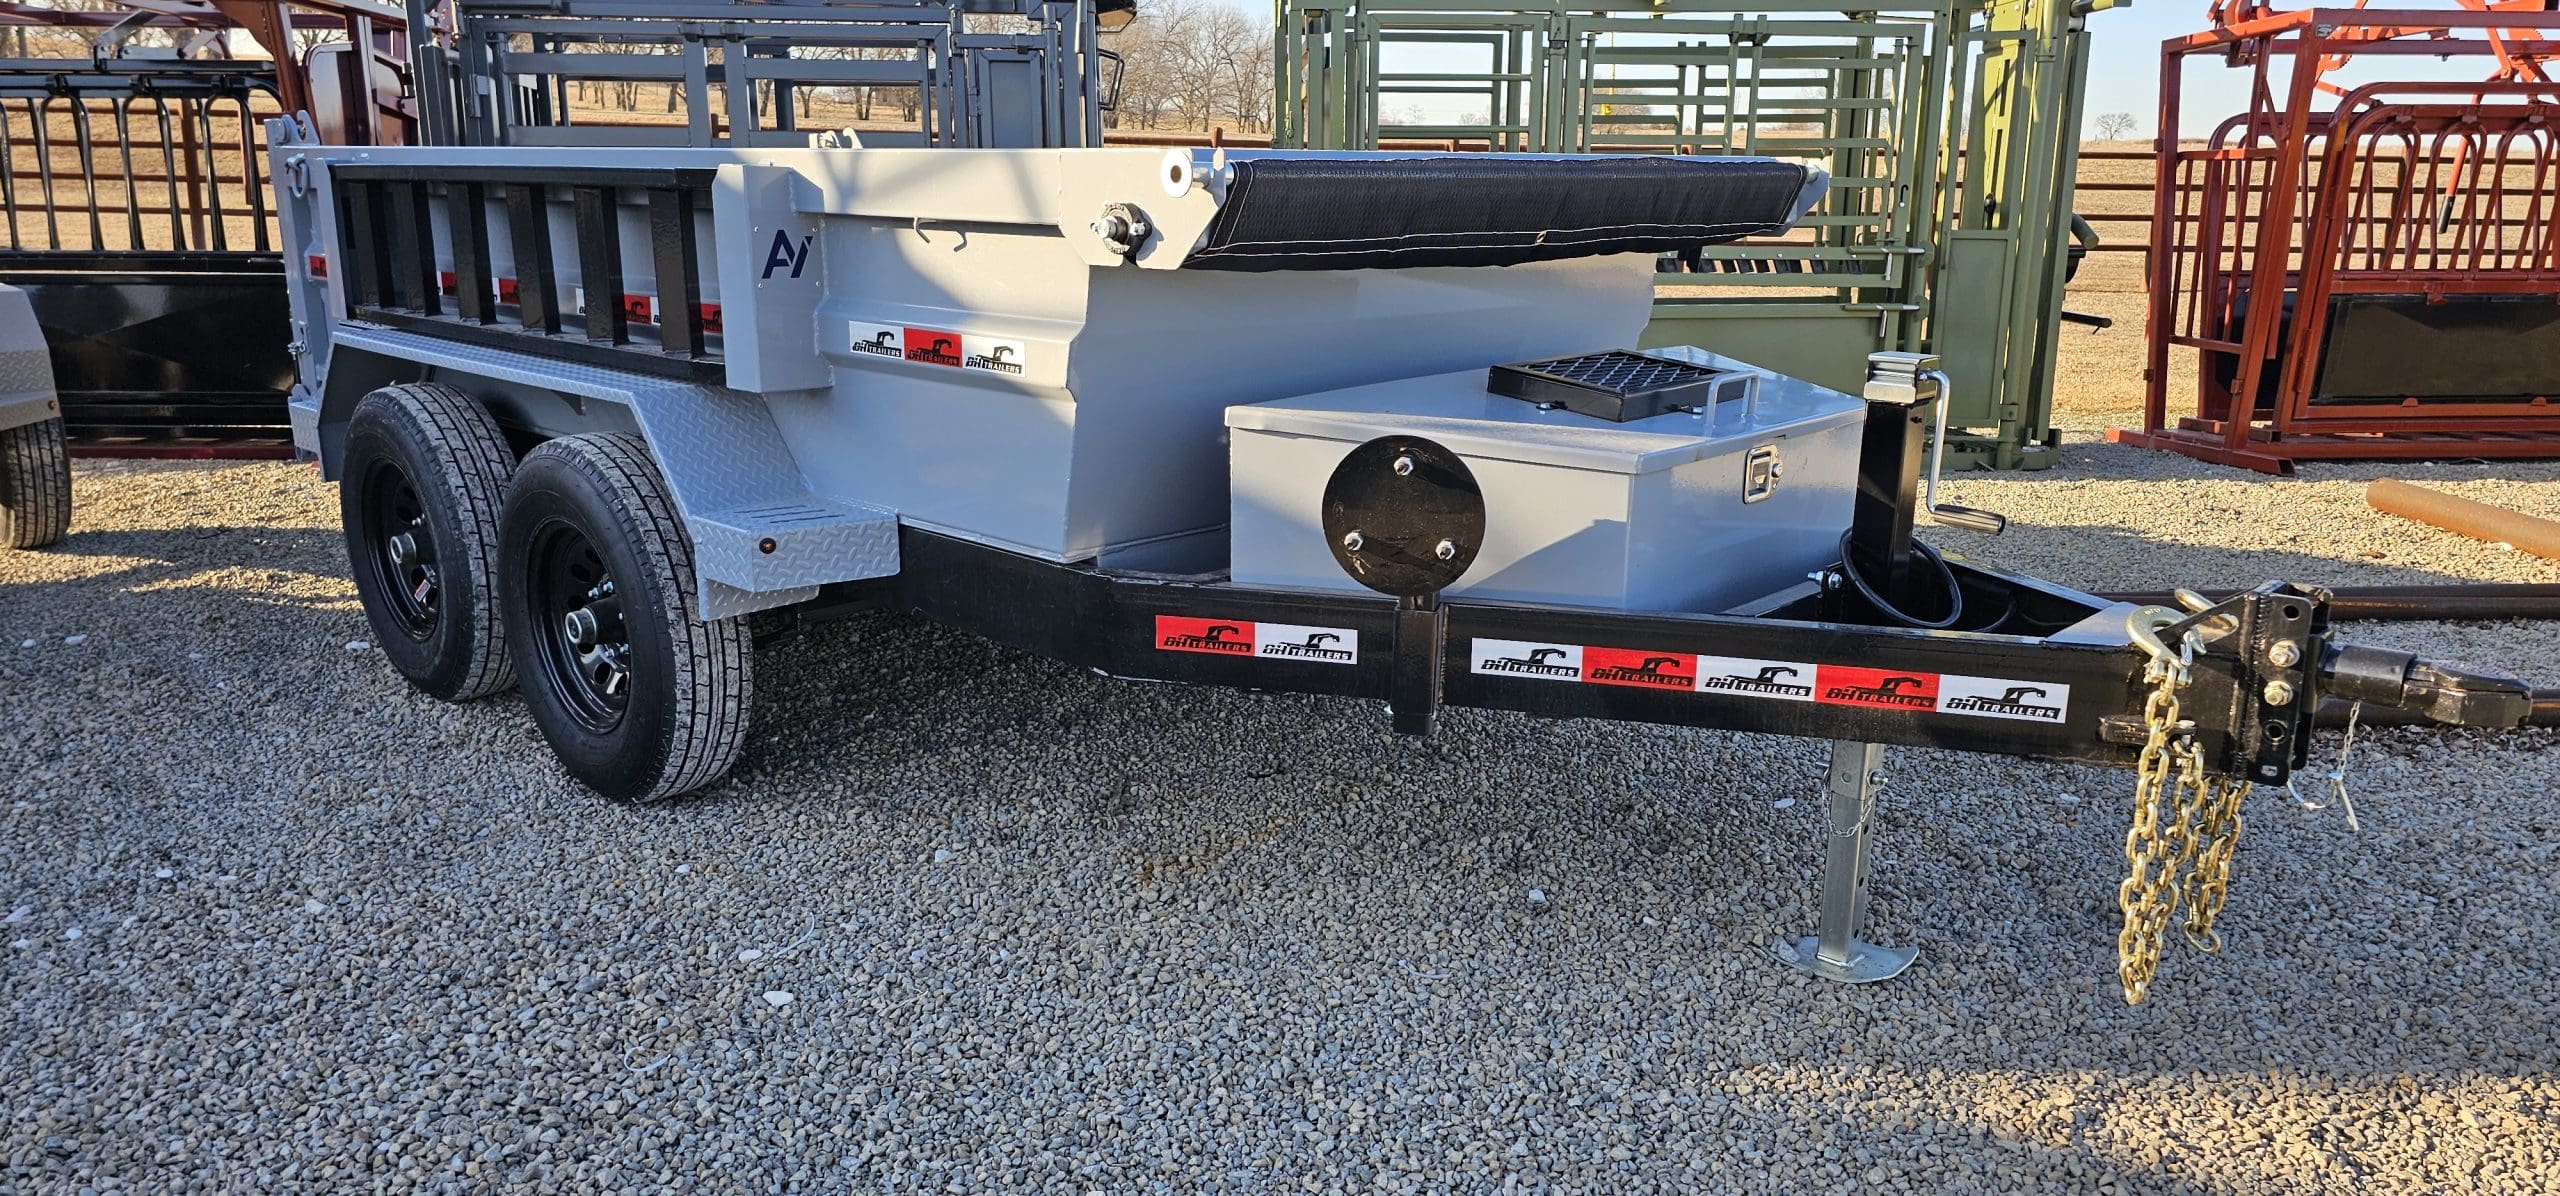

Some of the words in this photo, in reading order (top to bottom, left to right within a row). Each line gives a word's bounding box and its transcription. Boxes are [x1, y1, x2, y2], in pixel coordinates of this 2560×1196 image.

[868, 345, 901, 357] TRAILERS
[983, 361, 1020, 373] TRAILERS
[1191, 640, 1248, 653] TRAILERS
[1291, 648, 1349, 661] TRAILERS
[1512, 664, 1576, 677] TRAILERS
[1623, 672, 1689, 686] TRAILERS
[1739, 682, 1808, 697] TRAILERS
[1860, 693, 1931, 707] TRAILERS
[1982, 702, 2056, 717] TRAILERS
